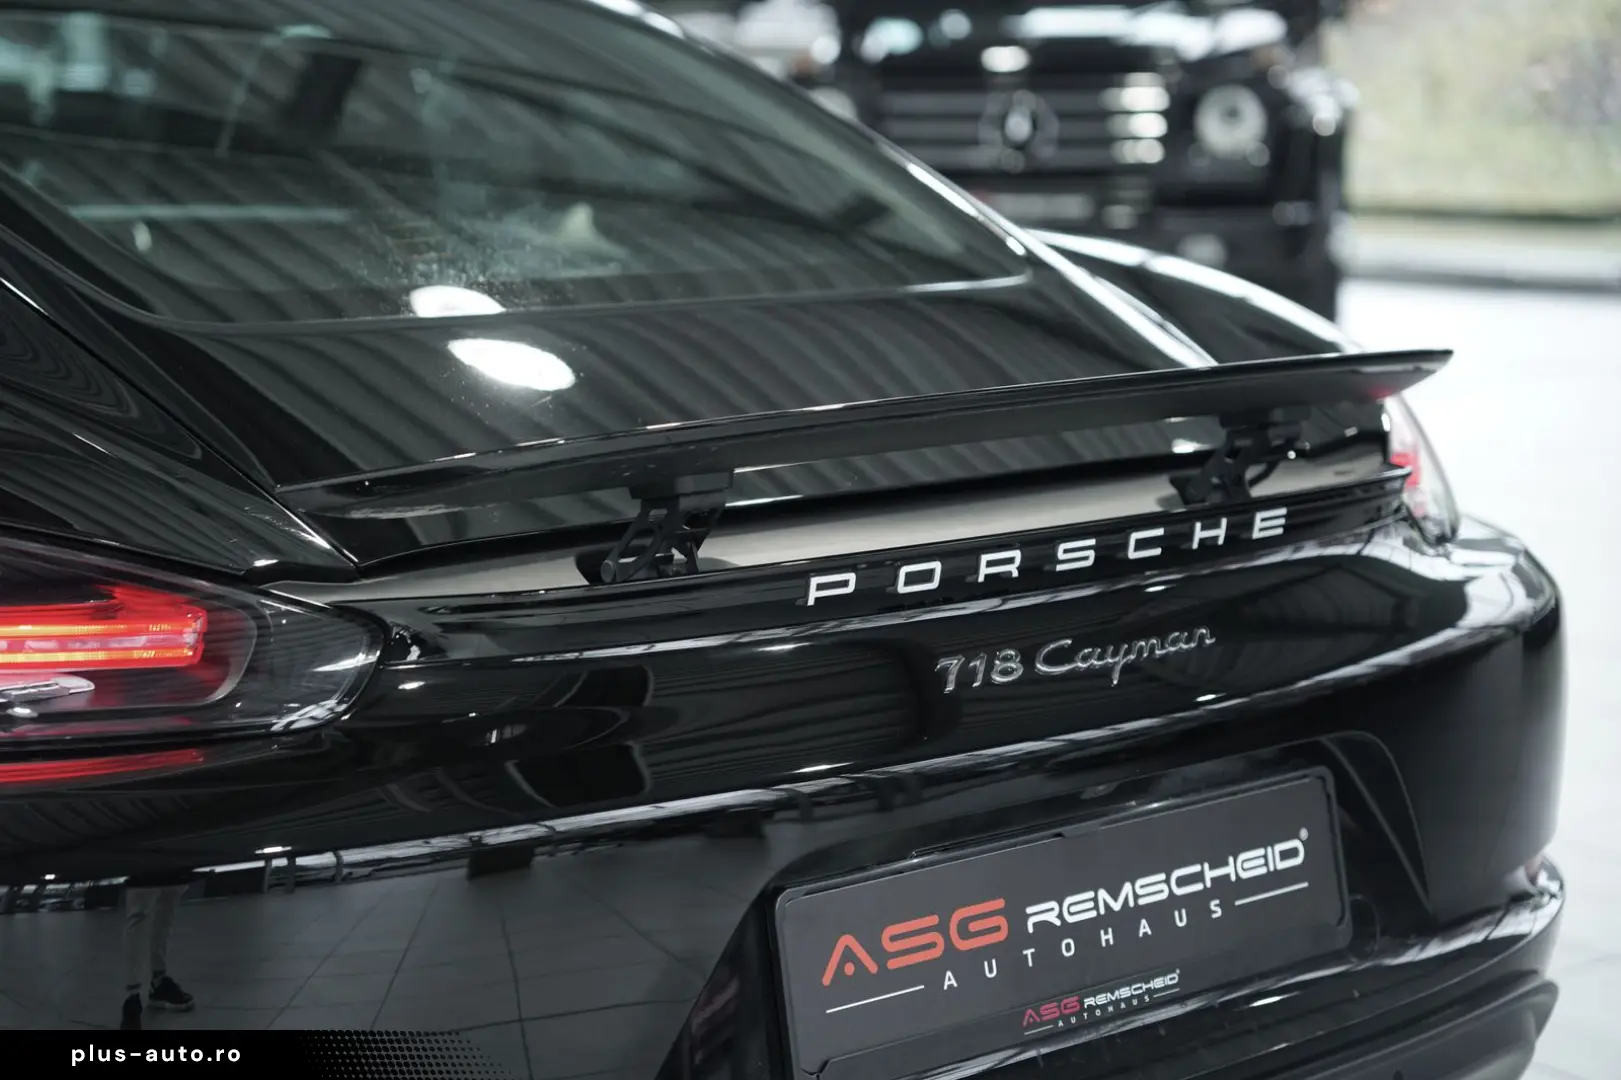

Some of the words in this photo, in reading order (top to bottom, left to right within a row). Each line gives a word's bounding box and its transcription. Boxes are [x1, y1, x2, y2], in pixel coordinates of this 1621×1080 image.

[806, 507, 1288, 607] PORSCHE
[934, 649, 1024, 694] 718
[1034, 625, 1216, 687] Cayman
[821, 898, 1009, 986] ASG
[1025, 837, 1306, 934] REMSCHEID
[942, 899, 1223, 990] AUTOHAUS
[1022, 996, 1081, 1027] ASG
[1083, 973, 1180, 1009] REMSCHEID
[1057, 995, 1150, 1028] AUTOHAUS
